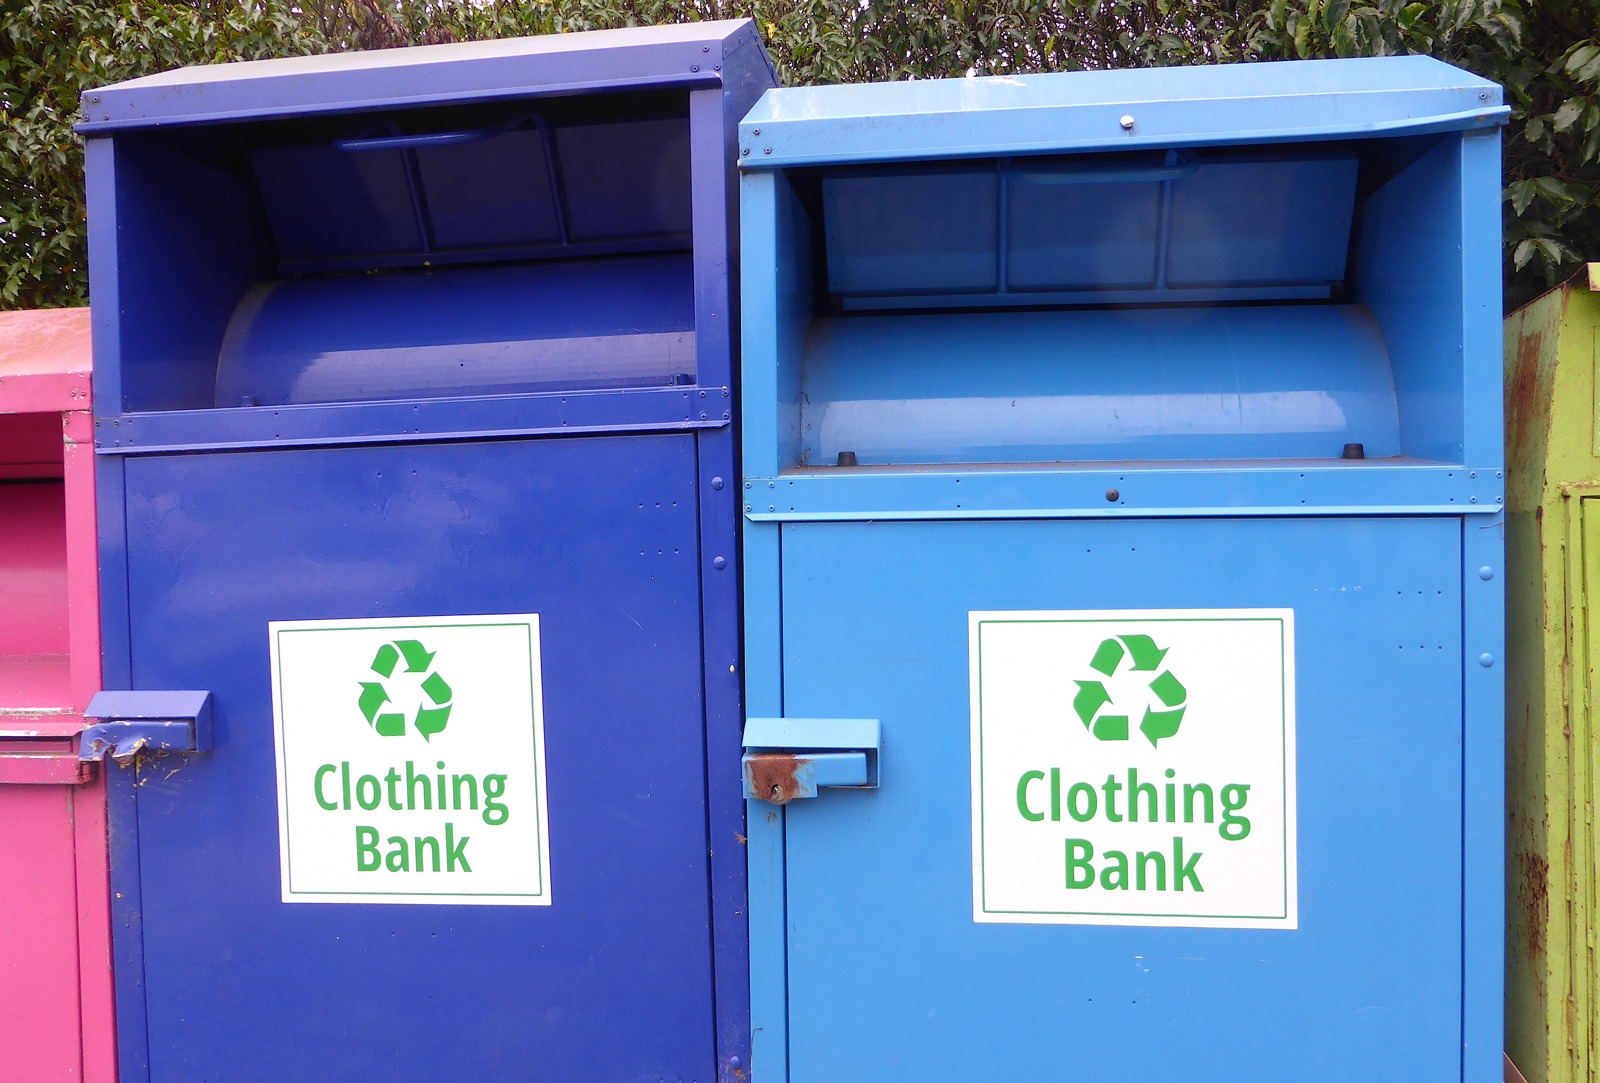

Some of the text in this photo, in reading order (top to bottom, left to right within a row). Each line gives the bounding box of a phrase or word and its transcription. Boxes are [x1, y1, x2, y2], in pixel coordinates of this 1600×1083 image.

[314, 760, 509, 826] Clothing
[1016, 767, 1251, 841] Clothing
[356, 822, 473, 873] Bank
[1065, 836, 1204, 893] Bank
